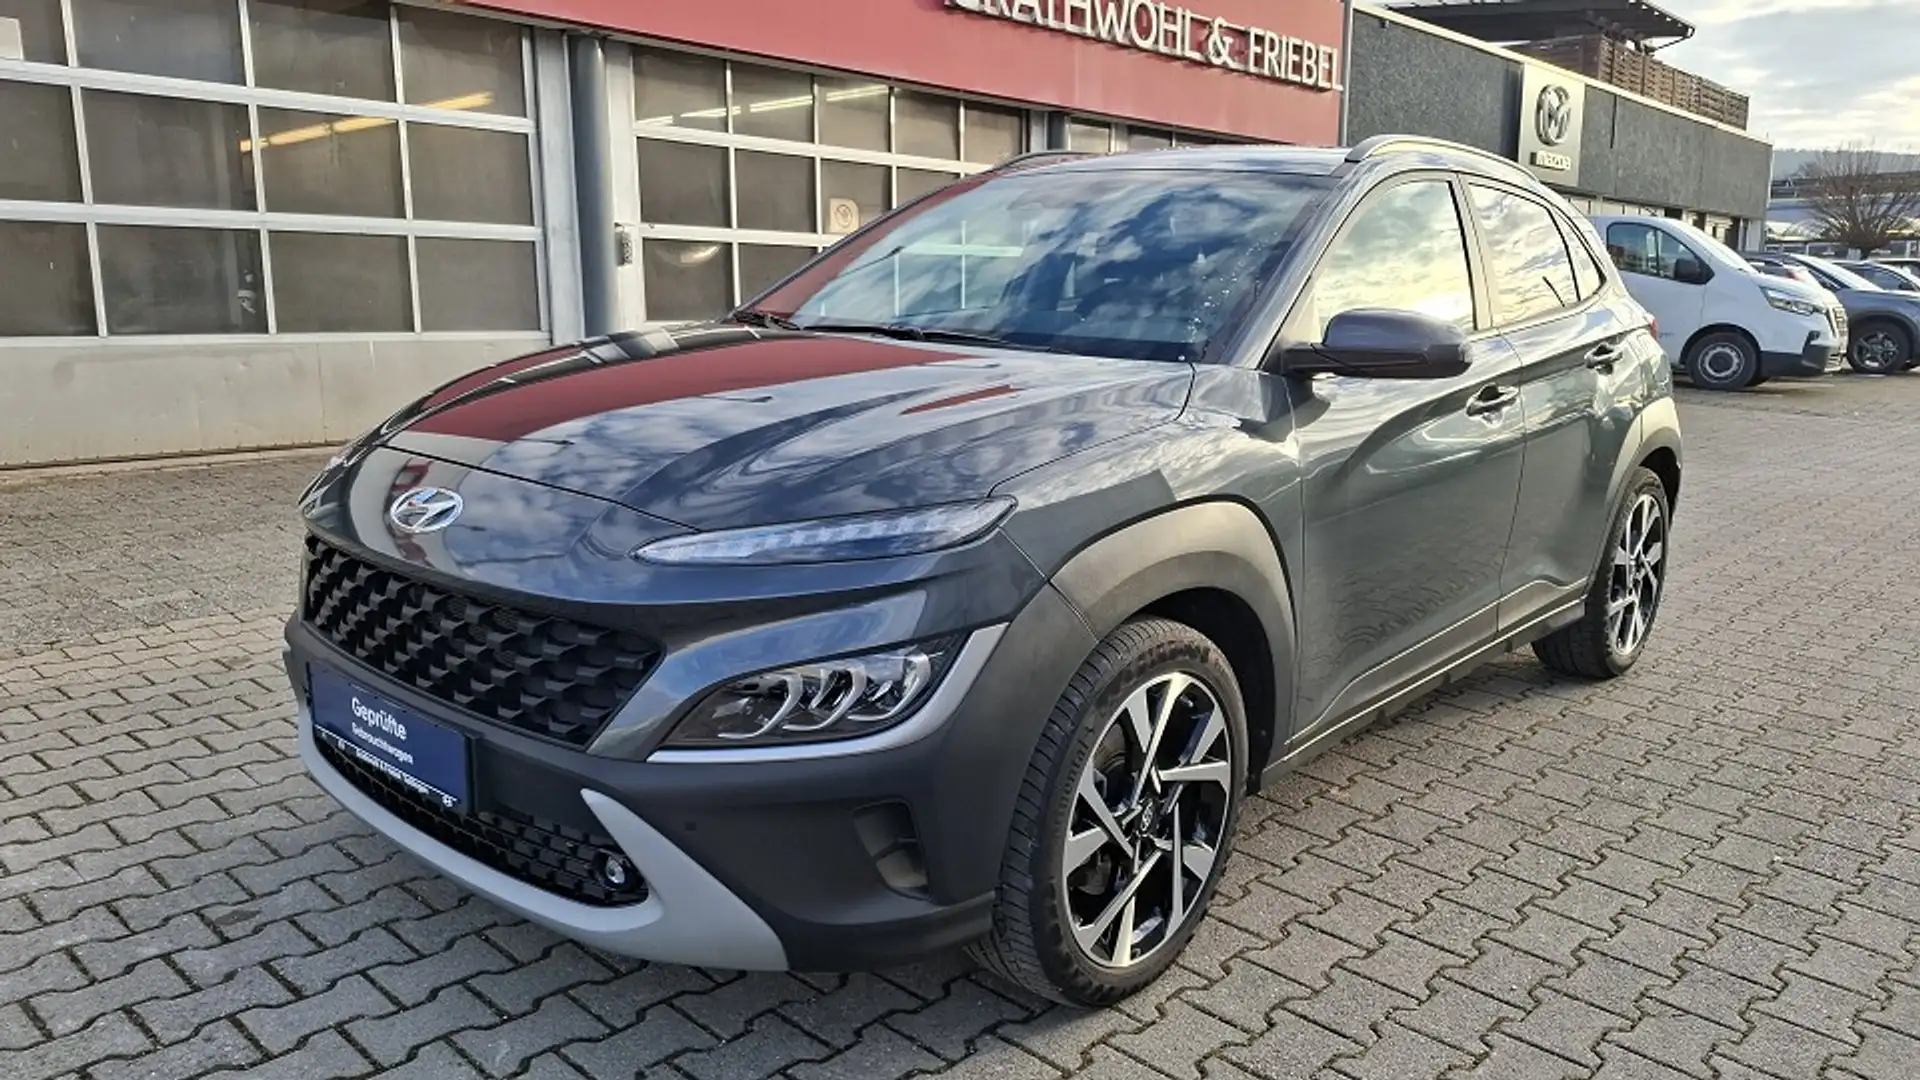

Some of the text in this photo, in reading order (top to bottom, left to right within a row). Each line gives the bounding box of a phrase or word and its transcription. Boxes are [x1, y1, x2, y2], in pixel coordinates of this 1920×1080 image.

[1208, 16, 1241, 69] &
[1250, 27, 1343, 91] FRIEBEL
[351, 697, 407, 741] Geprüfte
